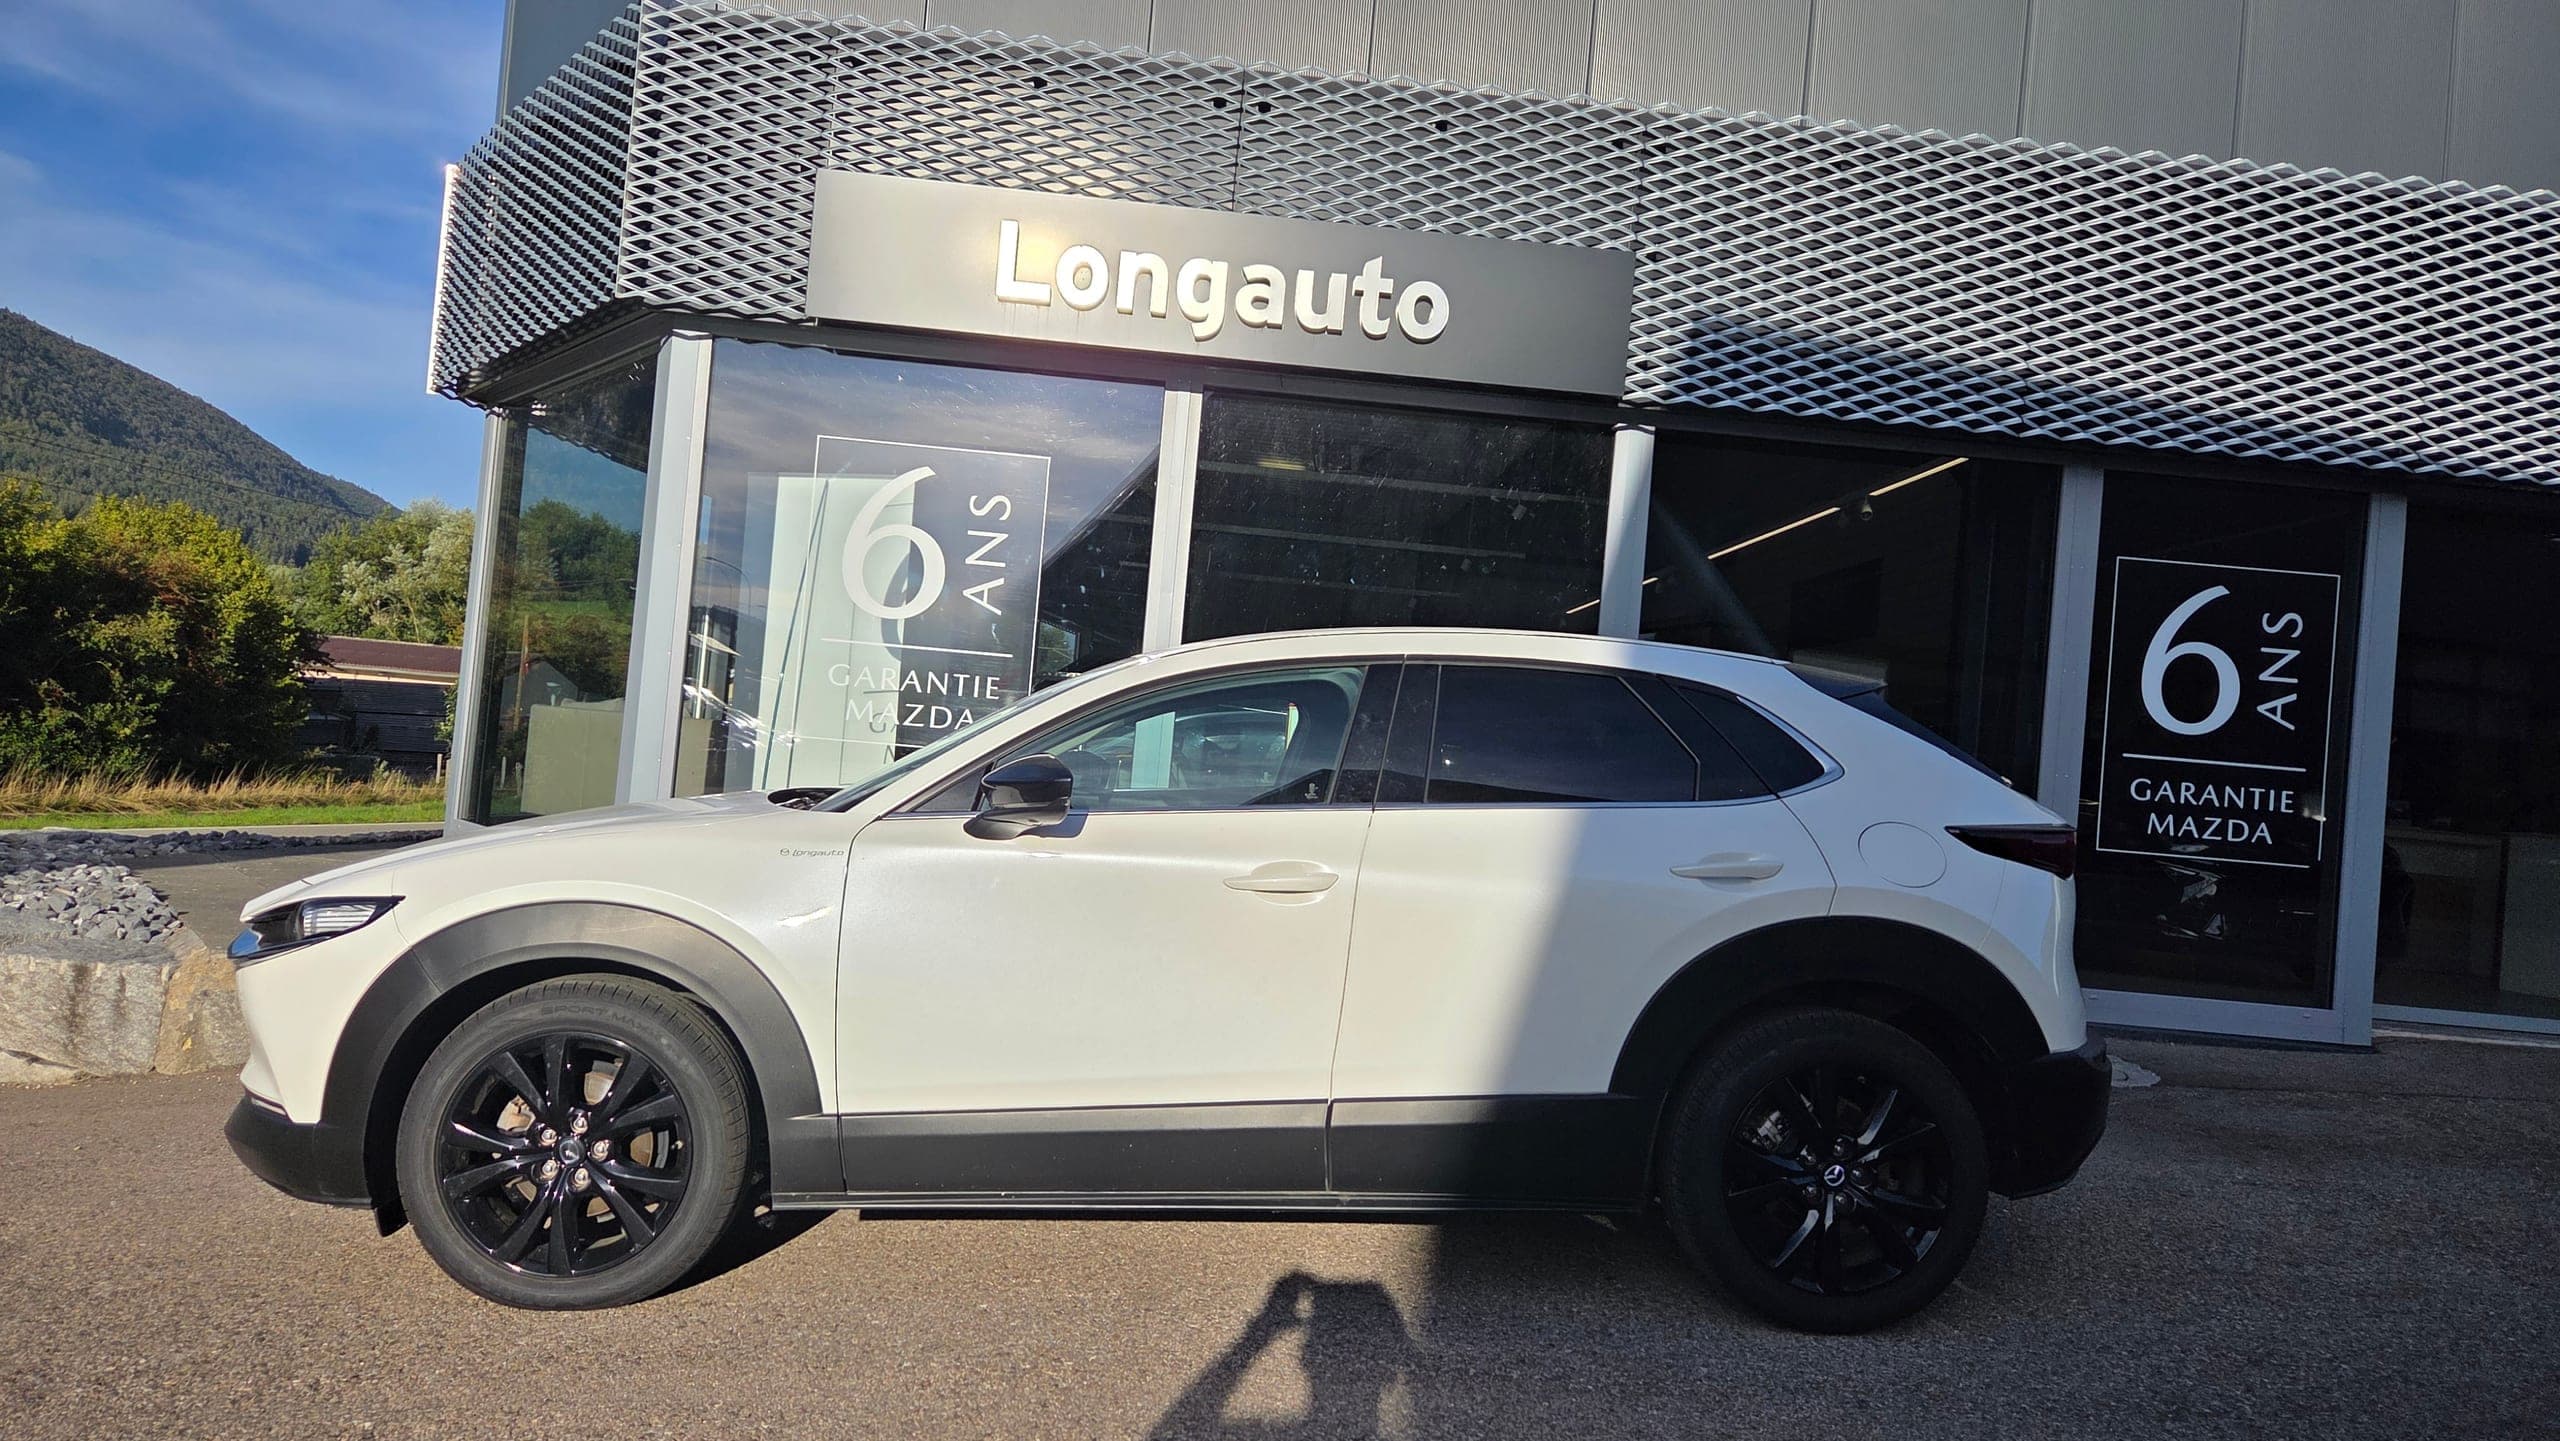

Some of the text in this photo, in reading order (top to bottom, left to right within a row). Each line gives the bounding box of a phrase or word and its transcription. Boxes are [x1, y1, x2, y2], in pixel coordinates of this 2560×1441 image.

[995, 219, 1450, 344] Longauto
[842, 466, 946, 620] 6
[962, 494, 1011, 616] ANS
[828, 663, 1001, 700] GARANTIE
[846, 699, 974, 730] MAZDA
[2141, 585, 2240, 736] 6
[2256, 612, 2303, 730] ANS
[2129, 778, 2295, 813] GARANTIE
[2147, 813, 2273, 845] MAZDA
